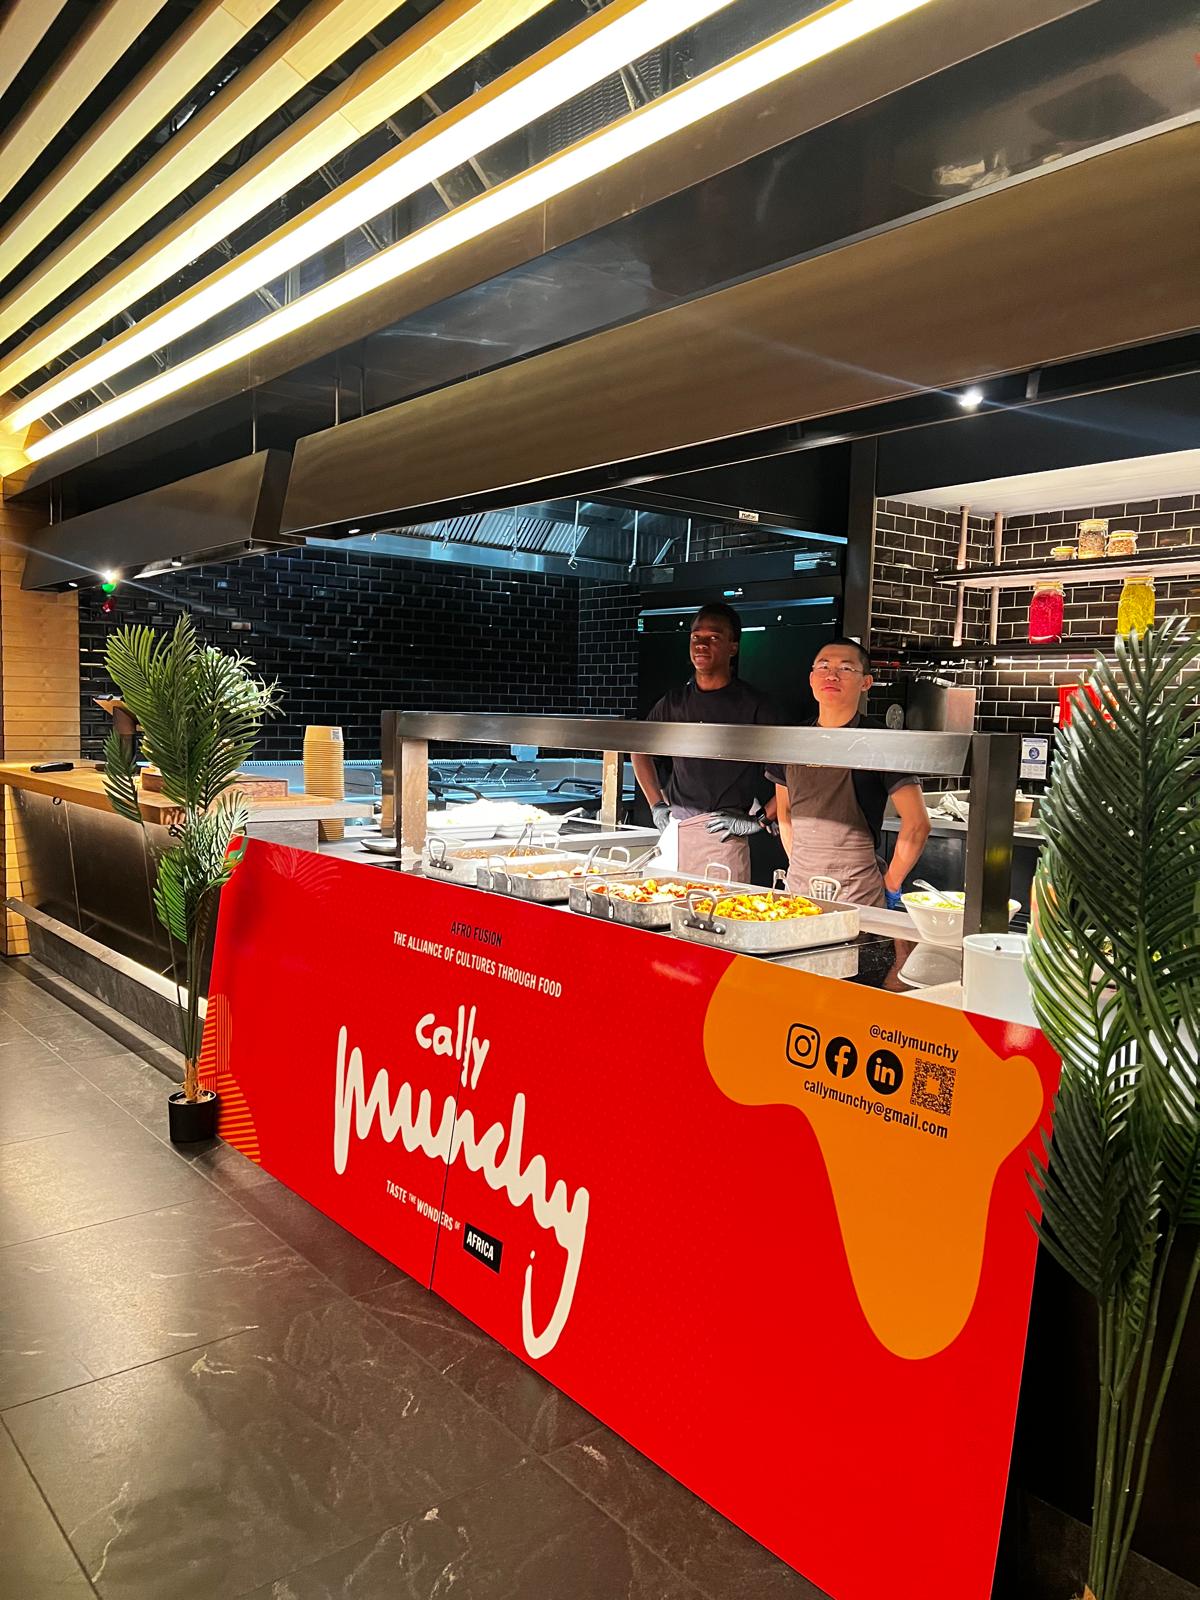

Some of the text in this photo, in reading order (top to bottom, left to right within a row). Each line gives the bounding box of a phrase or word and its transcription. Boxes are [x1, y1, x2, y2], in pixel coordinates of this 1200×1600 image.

[451, 921, 502, 947] AFRO FUSION
[393, 931, 562, 998] THE ALLIANCE OF CULTURES THROUGH FOOD
[869, 1025, 959, 1063] @callymunchy
[804, 1080, 948, 1139] callymunchy@gmail.com
[386, 1179, 408, 1204] TASTE
[408, 1193, 417, 1205] THE
[466, 1231, 494, 1261] AFRICA
